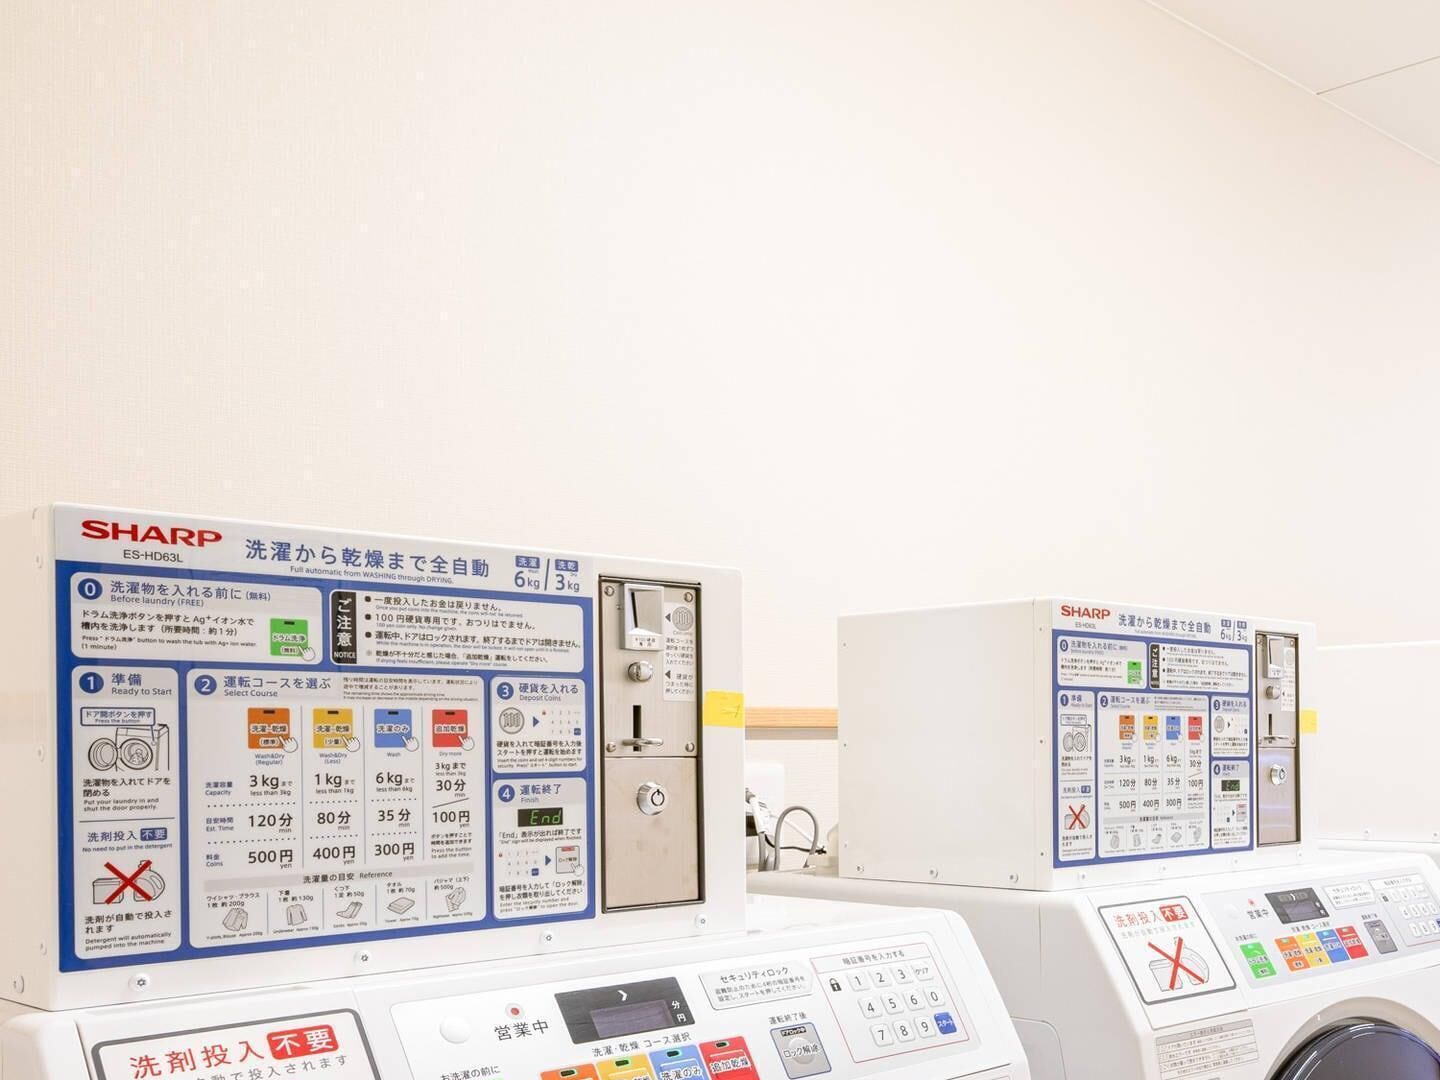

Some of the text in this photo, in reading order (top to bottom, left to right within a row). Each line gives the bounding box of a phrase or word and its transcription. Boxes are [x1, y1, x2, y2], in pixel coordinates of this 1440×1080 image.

[81, 519, 223, 548] SHARP
[122, 549, 184, 563] ES-HD63L
[244, 537, 490, 579] 洗濯から乾燥まで全自動
[290, 565, 304, 574] Full
[305, 566, 341, 576] automatic
[343, 569, 361, 578] from
[362, 571, 396, 581] WASHING
[397, 573, 425, 584] through
[110, 580, 242, 600] 洗濯物を入れる前に
[110, 594, 204, 608] Before laundry (FREE)
[374, 597, 502, 612] 一度投入したお金は戻りません。
[1060, 604, 1111, 621] SHARP
[336, 597, 353, 648] ご注意
[1117, 613, 1212, 635] 洗濯から乾燥まで全自動
[111, 671, 143, 687] 準備
[223, 674, 332, 690] 運転コースを選ぶ
[111, 686, 173, 698] Ready to Start
[223, 688, 278, 698] Select Course
[518, 682, 579, 694] 硬貨を入れる
[519, 694, 562, 702] Deposit Coins
[83, 777, 171, 788] 洗濯物を入れてドアを
[435, 778, 466, 792] 30分
[519, 783, 562, 796] 運転終了
[83, 787, 111, 798] 閉める
[204, 788, 232, 797] Capacity
[248, 812, 294, 829] 120分
[316, 810, 352, 826] 80分
[377, 808, 412, 823] 35分
[432, 810, 471, 824] 100円
[529, 809, 562, 826] End
[87, 830, 137, 843] 洗剤投入
[312, 845, 356, 861] 400円
[374, 841, 415, 857] 300円
[206, 860, 224, 868] Coins
[247, 849, 294, 865] 500円
[303, 872, 355, 885] 洗濯量の目安
[359, 870, 393, 880] Reference
[84, 909, 173, 925] 洗剤が自動で投入さ
[84, 924, 115, 935] れます
[841, 949, 905, 967] 暗証番号を入力する
[719, 965, 790, 985] セキュリティロック
[854, 975, 863, 987] 1
[876, 972, 886, 984] 2
[898, 969, 907, 980] 3
[888, 998, 897, 1010] 5
[910, 994, 919, 1006] 6
[929, 991, 939, 1003] 0
[671, 1000, 681, 1010] 分
[866, 1001, 875, 1013] 4
[676, 1012, 687, 1023] 円
[768, 1011, 807, 1025] 運転終了後
[493, 1018, 550, 1042] 営業中
[899, 1025, 909, 1037] 8
[920, 1021, 929, 1033] 9
[643, 1031, 692, 1049] コース選択
[877, 1029, 887, 1042] 7
[128, 1027, 333, 1080] 洗剤投入 不要
[710, 1056, 750, 1074] 追加乾燥
